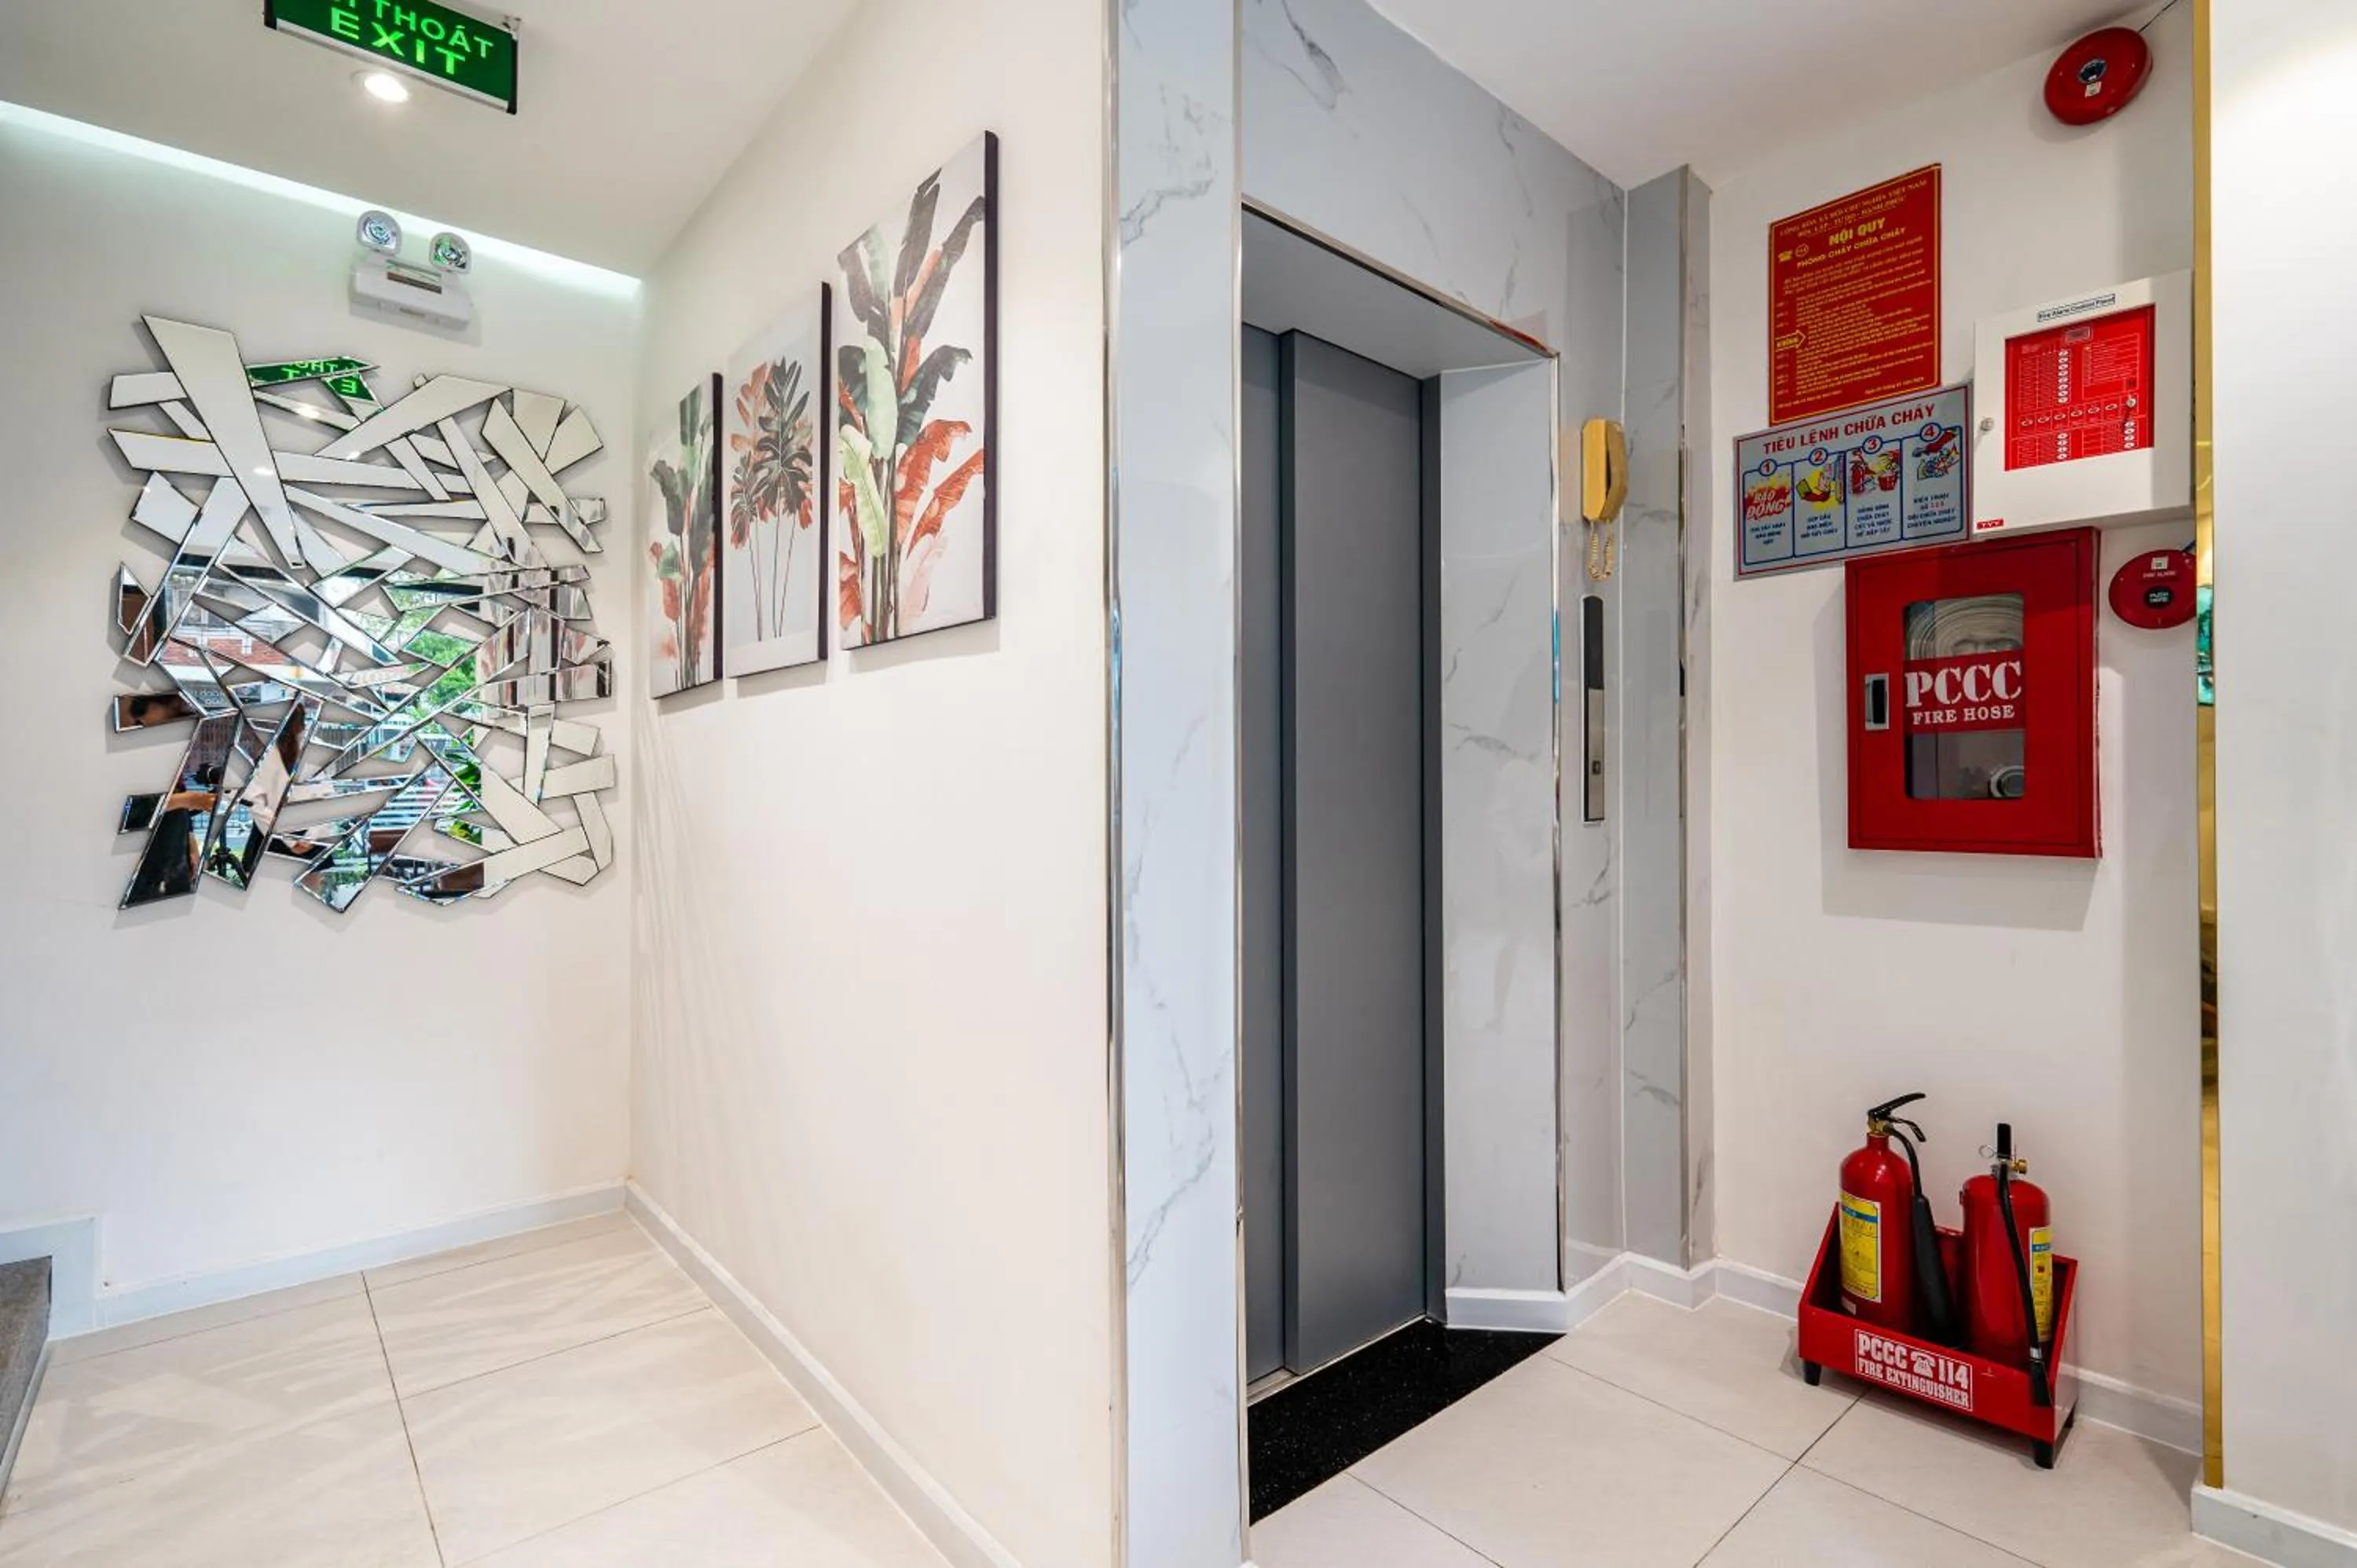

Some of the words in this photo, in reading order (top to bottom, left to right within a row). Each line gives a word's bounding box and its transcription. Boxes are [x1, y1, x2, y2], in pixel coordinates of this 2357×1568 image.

[332, 7, 466, 75] EXIT
[1829, 229, 1853, 246] NỘI
[1800, 426, 1839, 449] LỆNH
[1844, 414, 1887, 437] CHỮA
[1891, 402, 1936, 426] CHÁY
[1923, 425, 1935, 438] 4
[1813, 450, 1824, 462] 2
[1868, 439, 1878, 450] 3
[1904, 661, 2022, 707] PCCC
[1913, 709, 1957, 725] FIRE
[1964, 705, 2015, 722] HOSE
[1858, 1333, 1908, 1368] PCCC
[1938, 1357, 1969, 1390] 114
[1858, 1357, 1883, 1379] FIRE
[1886, 1366, 1970, 1408] EXTINGUISHER
